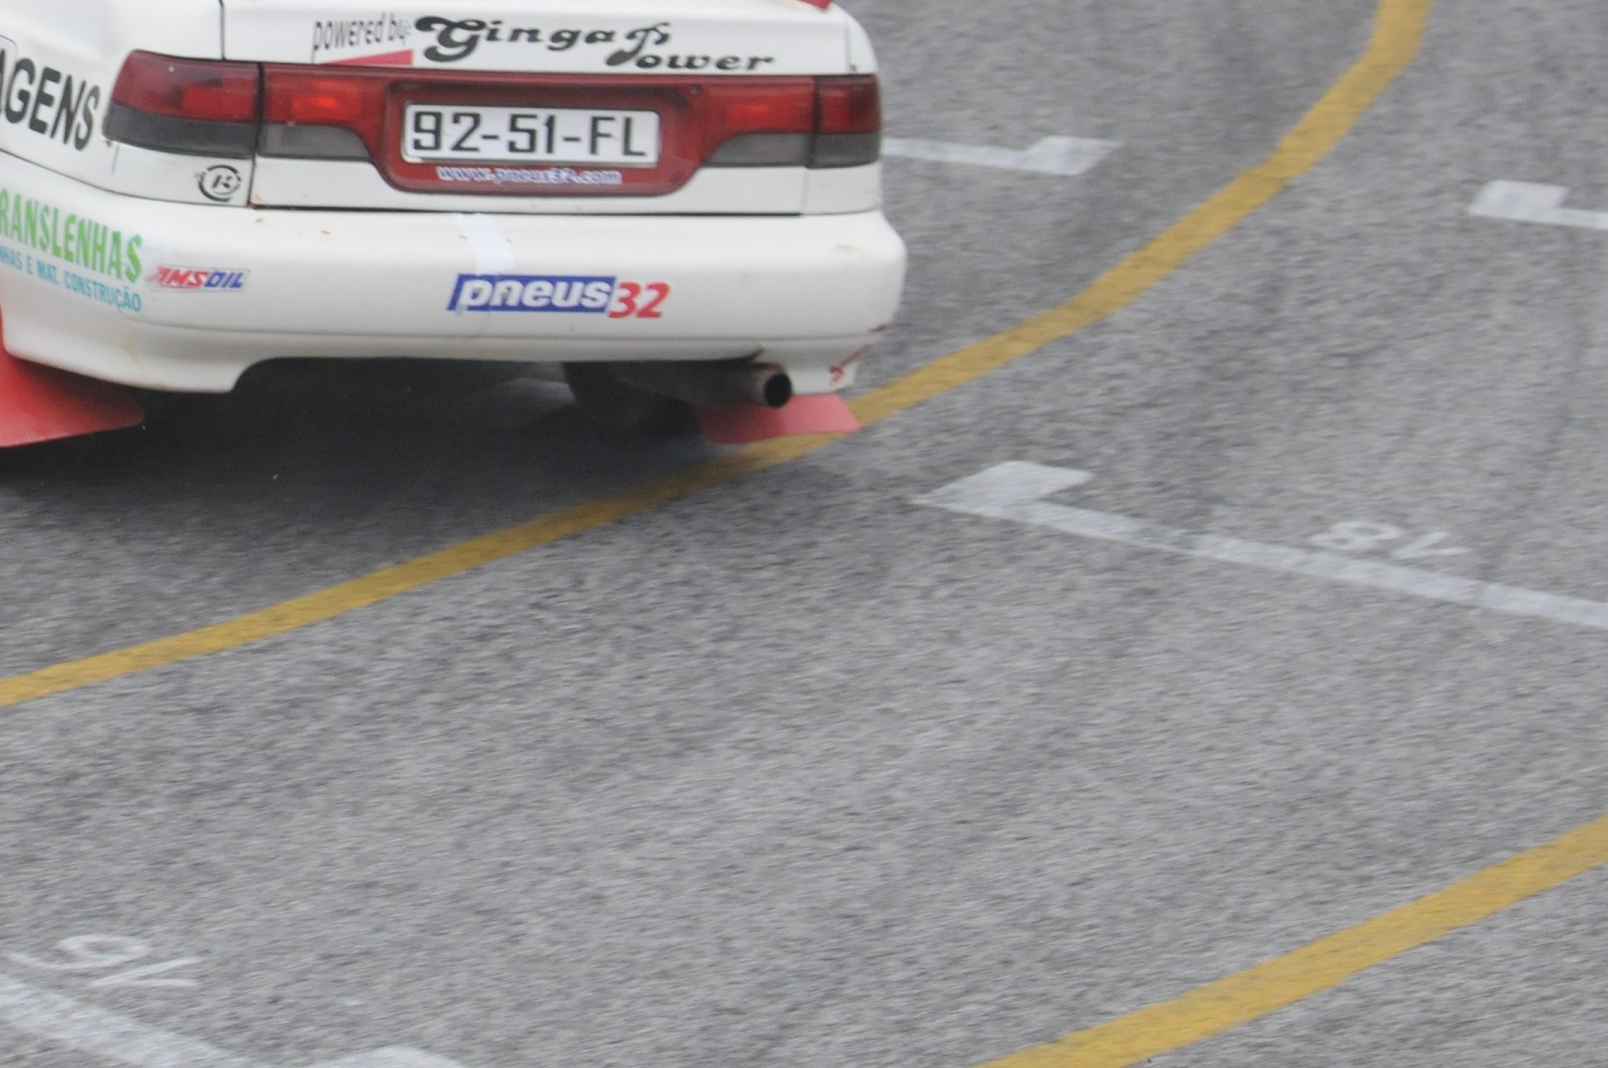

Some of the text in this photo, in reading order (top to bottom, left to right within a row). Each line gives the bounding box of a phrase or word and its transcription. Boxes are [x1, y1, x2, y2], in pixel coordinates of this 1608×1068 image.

[311, 11, 386, 64] powered
[414, 15, 775, 71] Ginga Power
[411, 110, 647, 158] 92-51-FL
[25, 255, 34, 276] E
[63, 269, 142, 314] CONSTRUÇÃO
[149, 265, 245, 289] AMSOIL
[455, 277, 671, 319] pneus32
